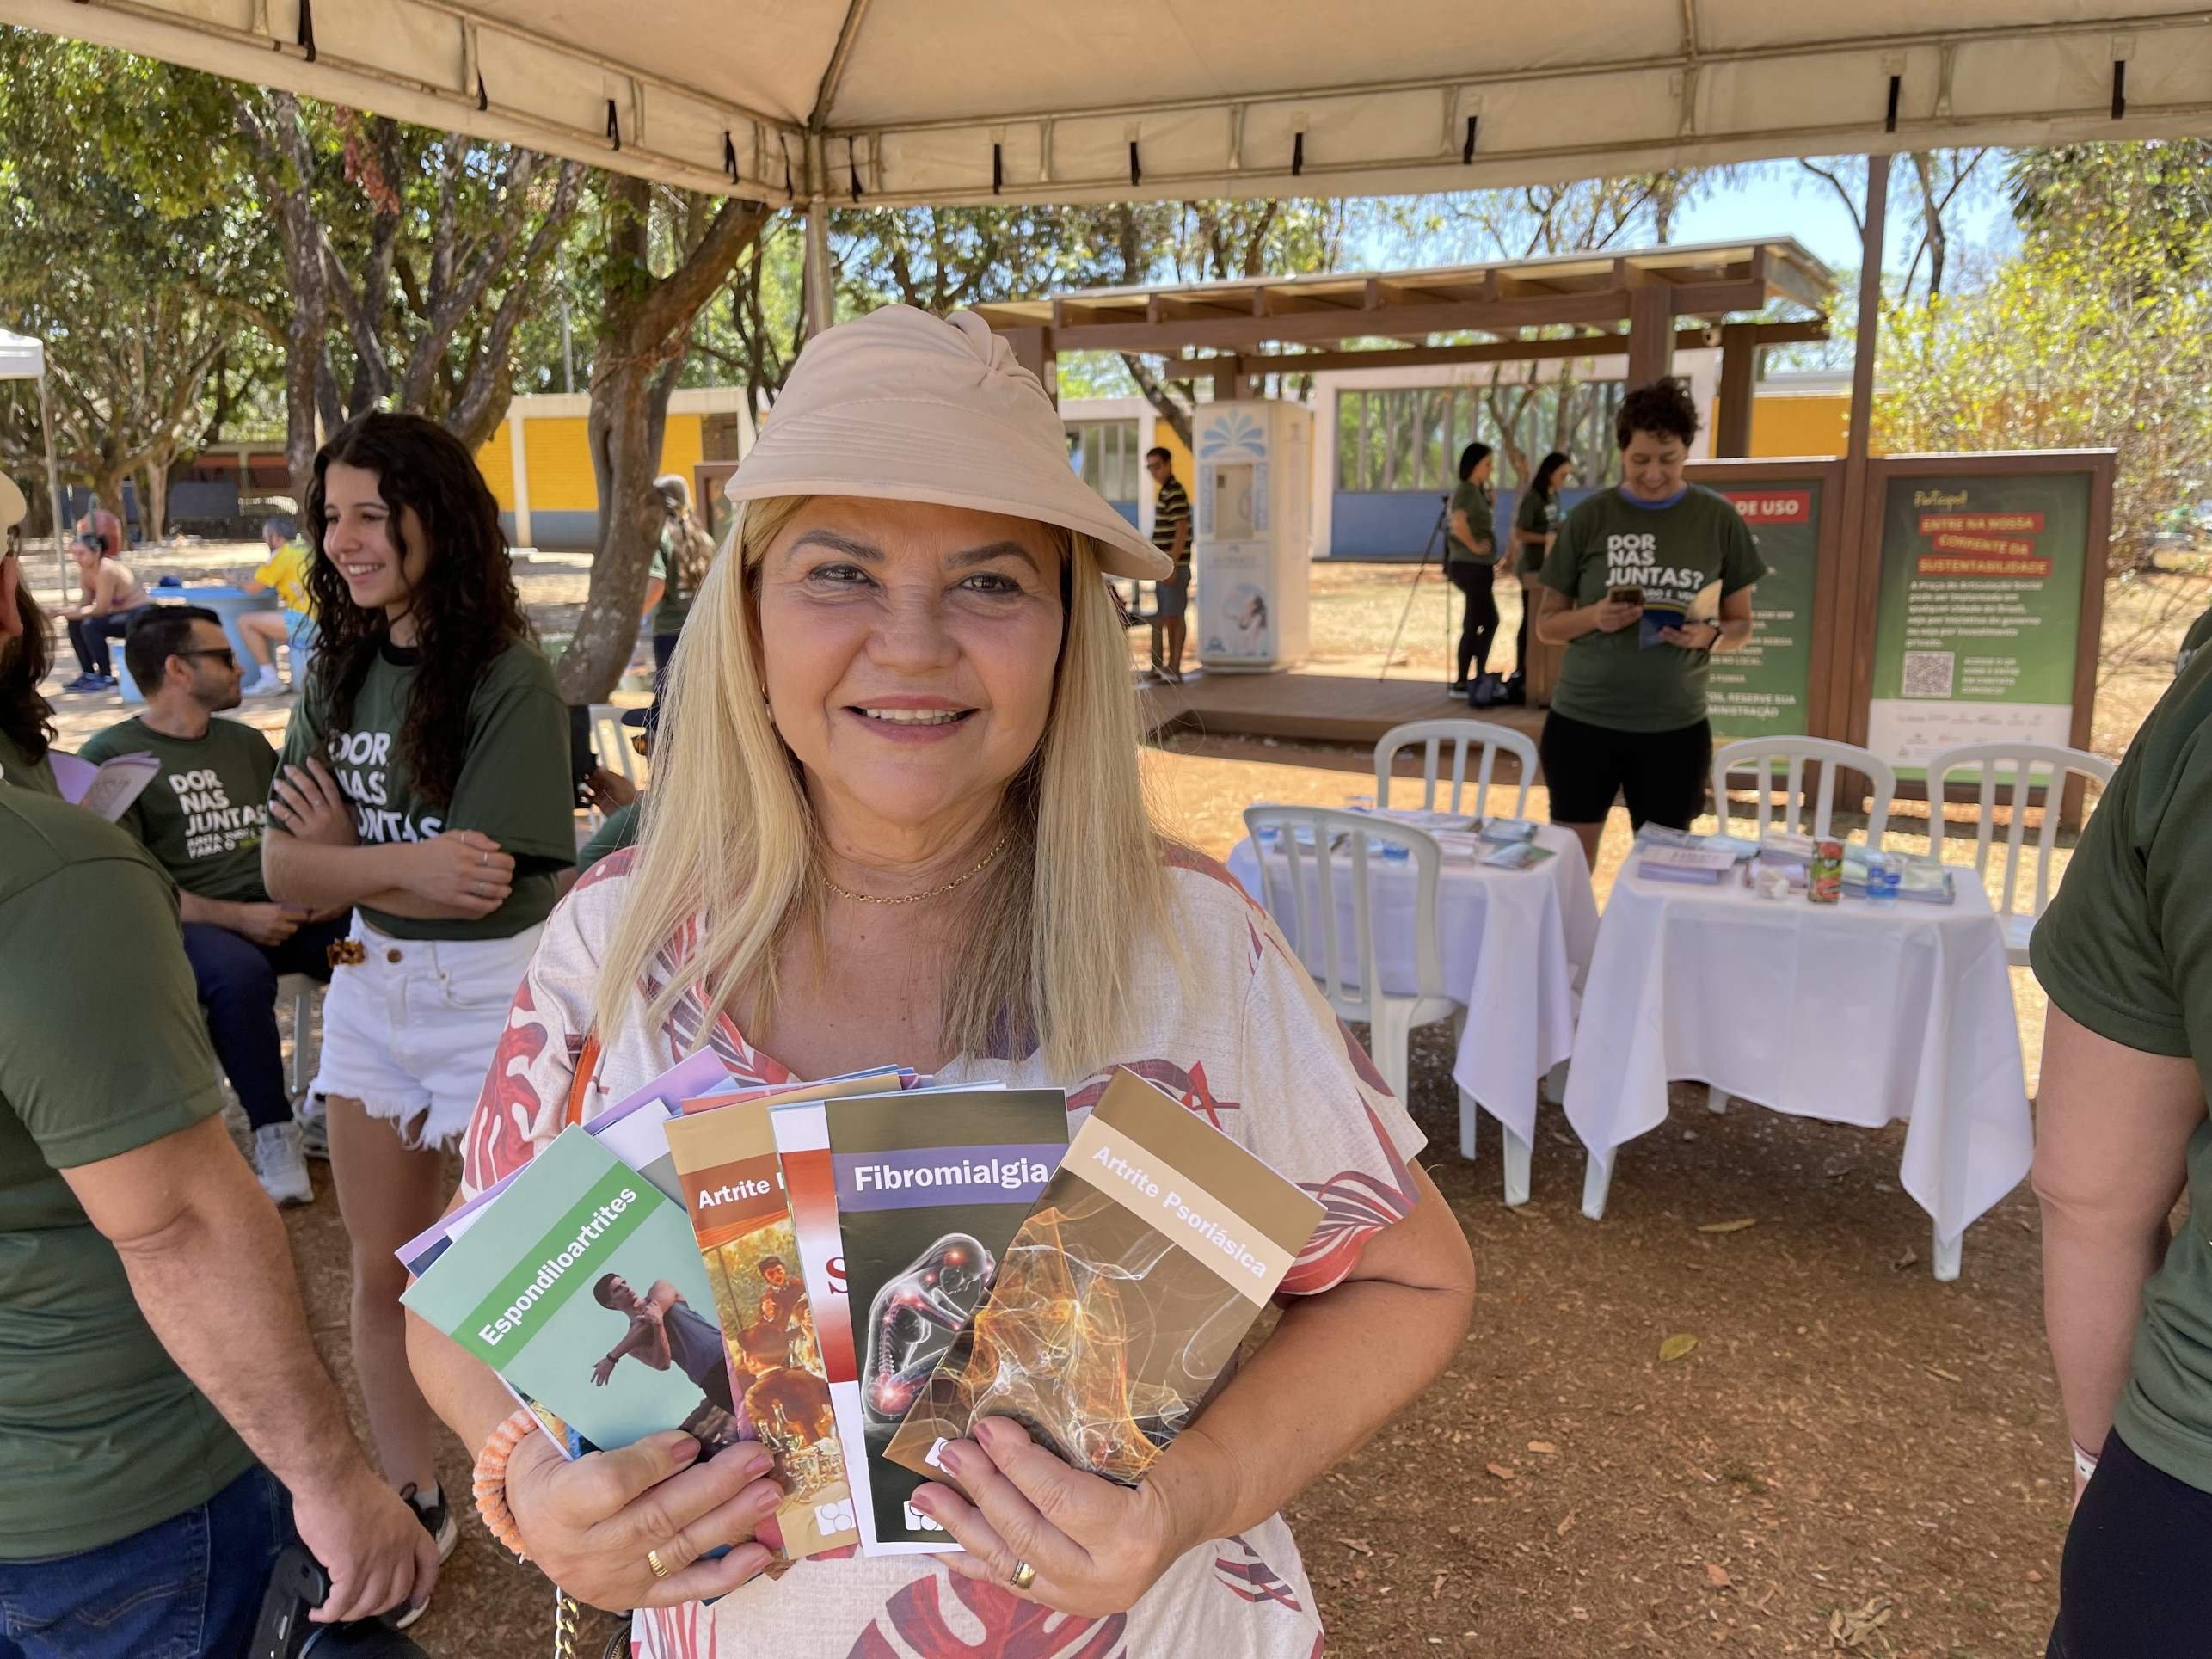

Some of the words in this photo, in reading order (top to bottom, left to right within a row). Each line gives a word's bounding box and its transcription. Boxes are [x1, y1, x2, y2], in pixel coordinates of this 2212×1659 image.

[1736, 500, 1759, 516] DE
[1760, 499, 1800, 516] USO
[1921, 518, 1965, 532] ENTRE
[1966, 518, 1986, 531] NA
[1987, 517, 2035, 531] NOSSA
[1607, 533, 1656, 551] DOR
[1938, 533, 2008, 554] CORRENTE
[2008, 542, 2029, 556] DA
[1607, 550, 1656, 568] NAS
[1919, 558, 2048, 574] SUSTENTABILIDADE
[1605, 567, 1705, 590] JUNTAS?
[1728, 692, 1773, 704] RESERVE
[1706, 705, 1779, 721] MINISTRAÇÃO
[168, 769, 224, 794] DOR
[179, 789, 230, 815] NAS
[854, 1158, 1048, 1191] Fibromialgia
[698, 1179, 771, 1209] Artrite
[1091, 1146, 1160, 1198] Artrite
[1162, 1190, 1267, 1279] Psoriásica
[478, 1188, 637, 1346] Espondiloartrites
